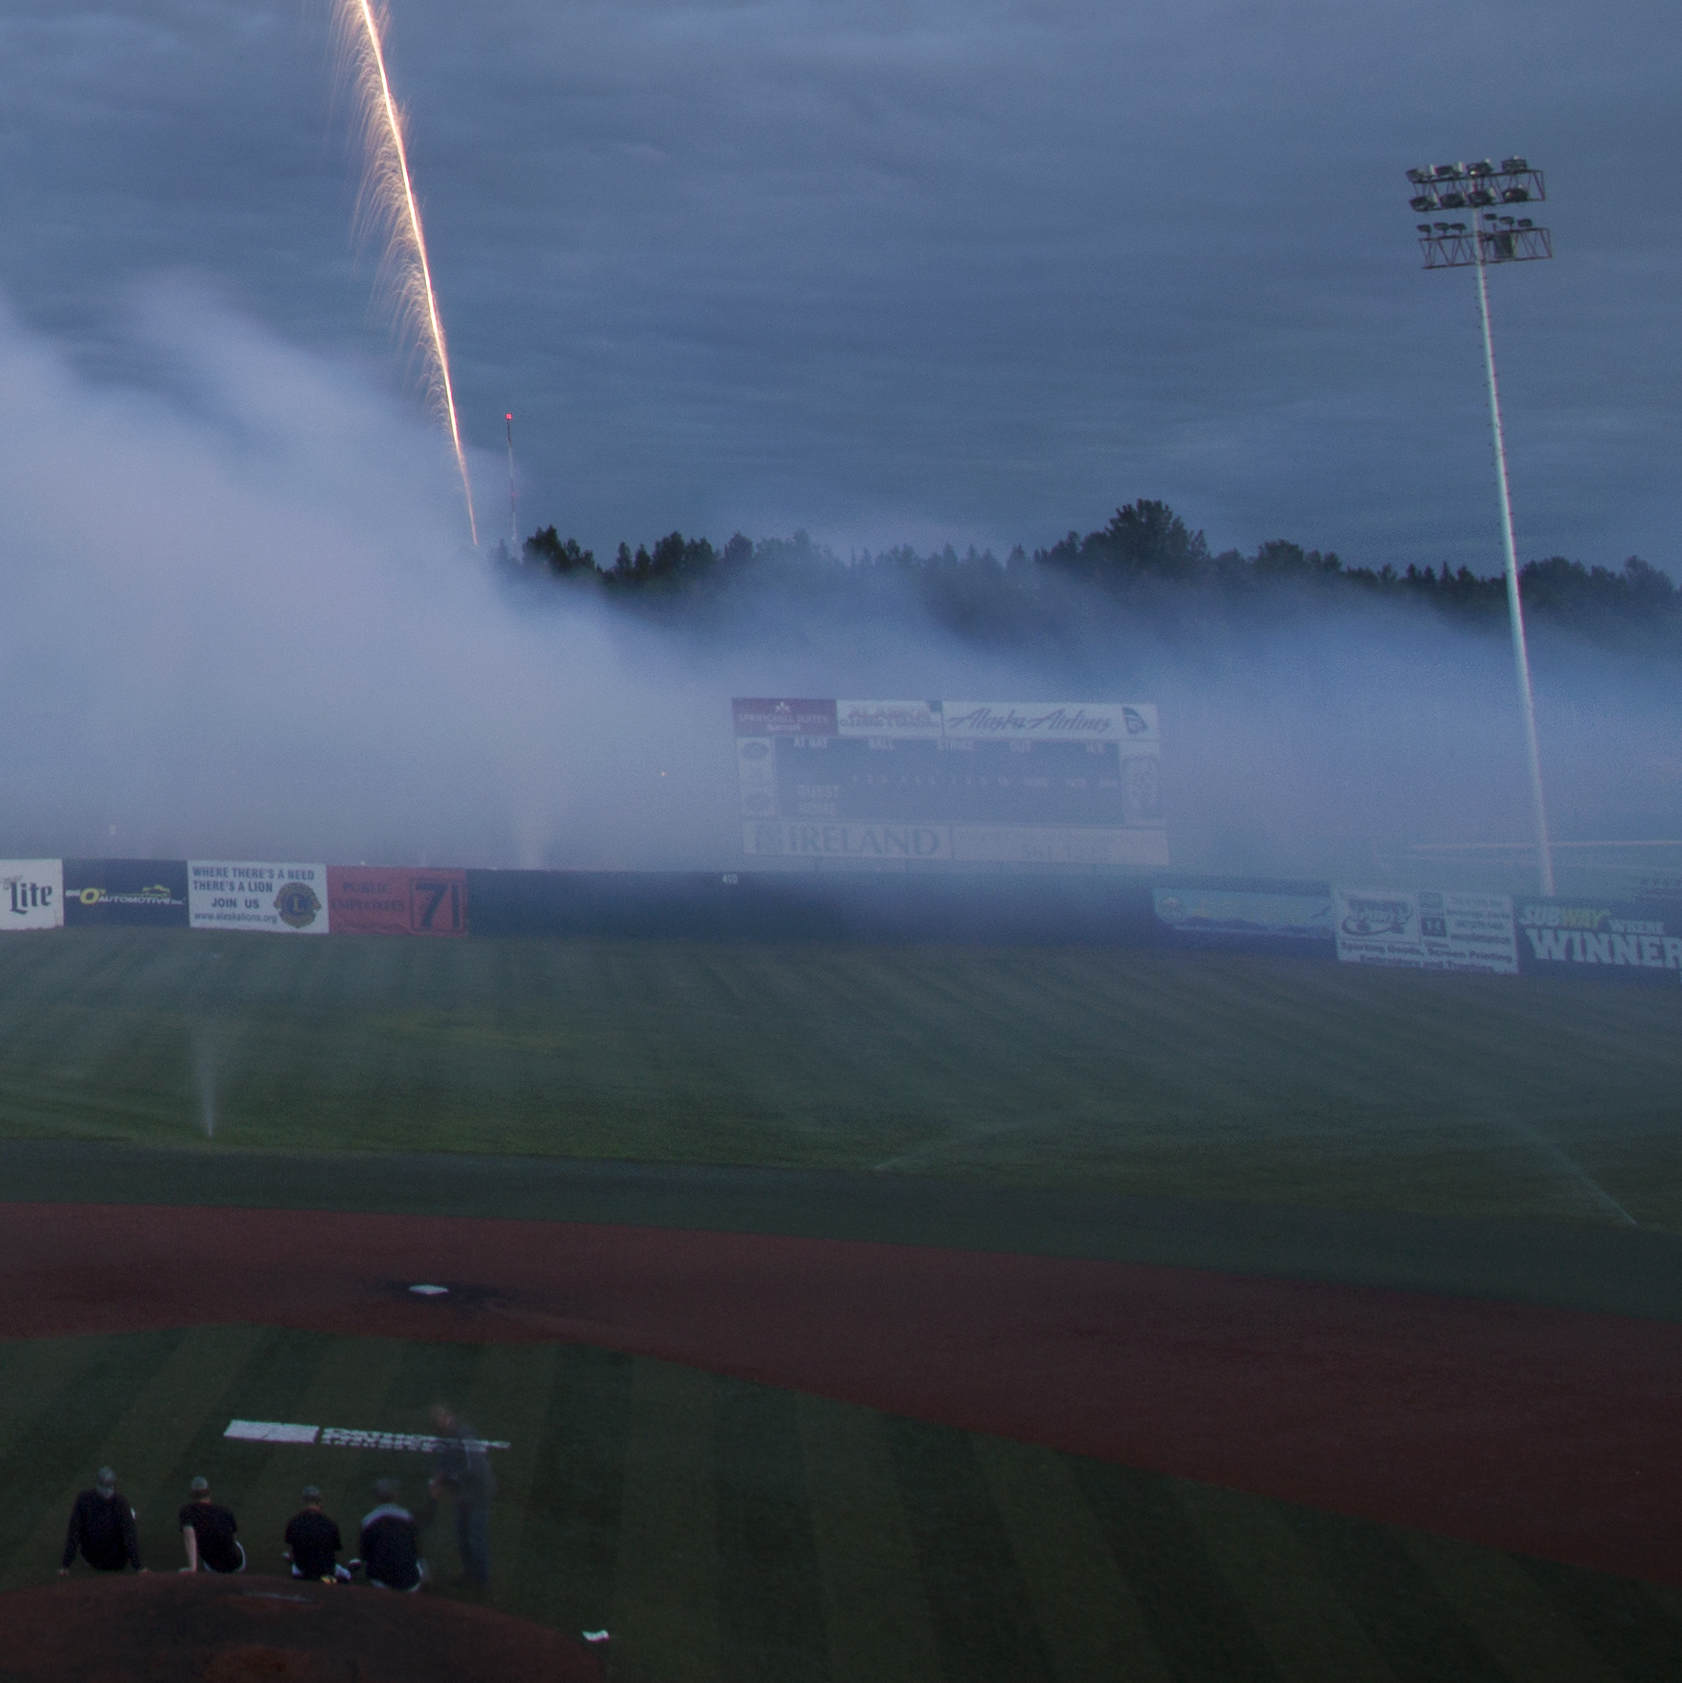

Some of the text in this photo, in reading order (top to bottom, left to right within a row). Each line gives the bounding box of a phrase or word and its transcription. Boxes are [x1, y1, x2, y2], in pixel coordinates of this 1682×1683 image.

[947, 707, 1026, 732] Alaska
[1026, 707, 1111, 734] Airlines
[789, 825, 940, 856] IRELAND
[192, 867, 314, 880] WHERE THERE'S A NEED
[193, 880, 273, 893] THERE'S A LION
[10, 881, 52, 915] Lite
[98, 895, 171, 905] AUTOMOTIVE
[211, 898, 259, 909] JOIN US
[1518, 905, 1612, 929] SUBWAY
